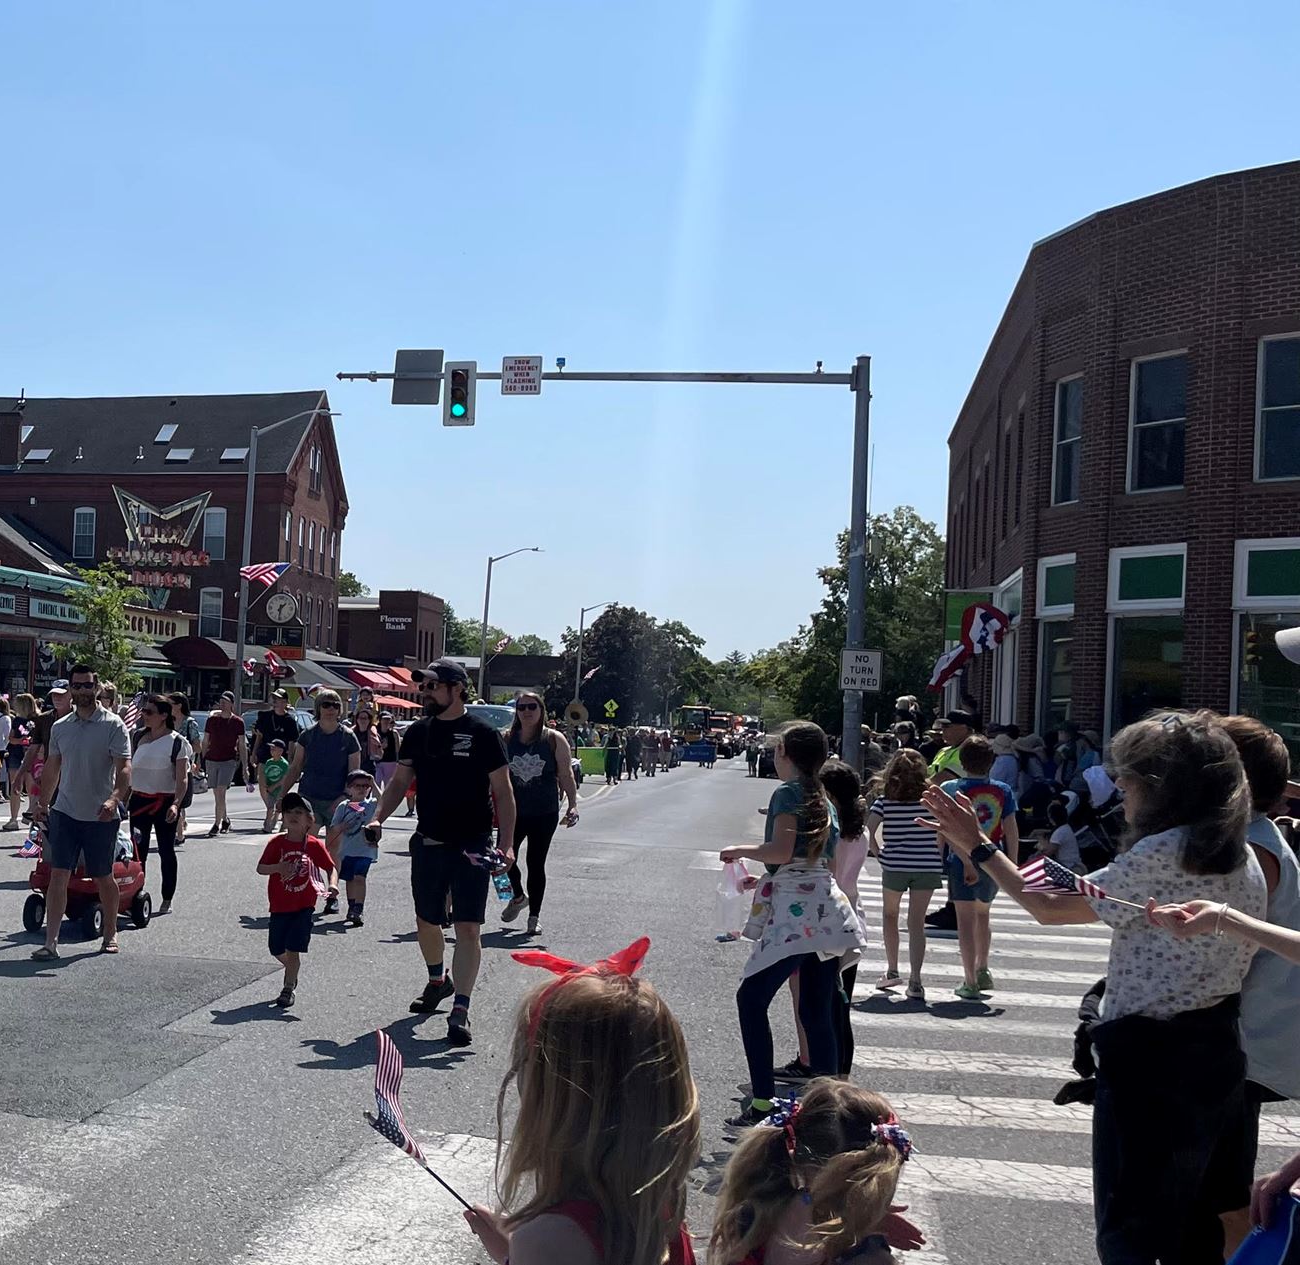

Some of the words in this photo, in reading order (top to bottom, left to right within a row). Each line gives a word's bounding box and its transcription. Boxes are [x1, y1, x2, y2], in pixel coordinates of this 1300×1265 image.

[380, 615, 412, 623] Florence
[147, 618, 177, 637] DINER
[855, 655, 870, 663] NO
[850, 665, 874, 675] TURN
[843, 676, 857, 685] ON
[860, 677, 878, 687] RED
